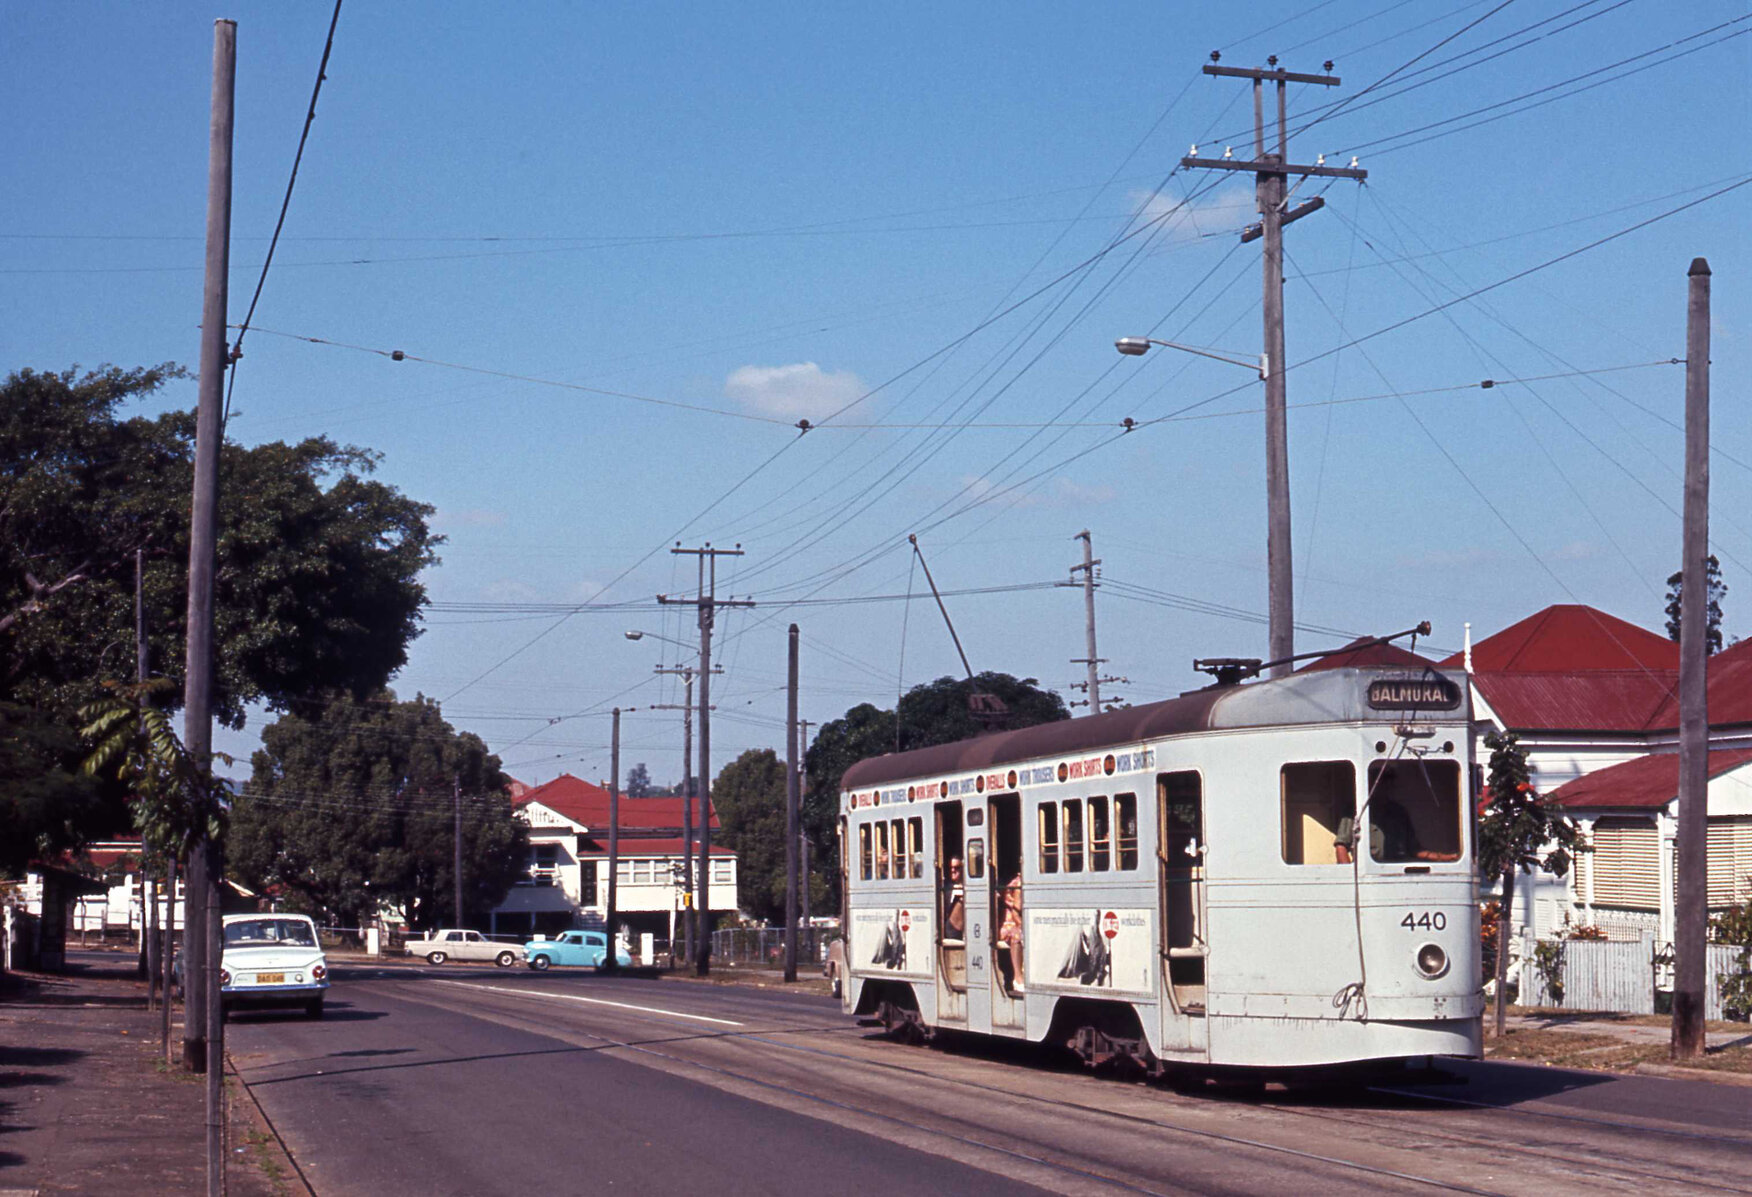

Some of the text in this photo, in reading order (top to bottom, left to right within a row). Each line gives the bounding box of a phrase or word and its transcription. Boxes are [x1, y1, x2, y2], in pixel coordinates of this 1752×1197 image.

[1069, 762, 1083, 779] WORK
[1083, 757, 1102, 777] SHIRTS
[1117, 754, 1132, 773] WORK
[1133, 750, 1155, 771] SHORTS
[1401, 911, 1446, 931] 440
[972, 955, 983, 970] 440
